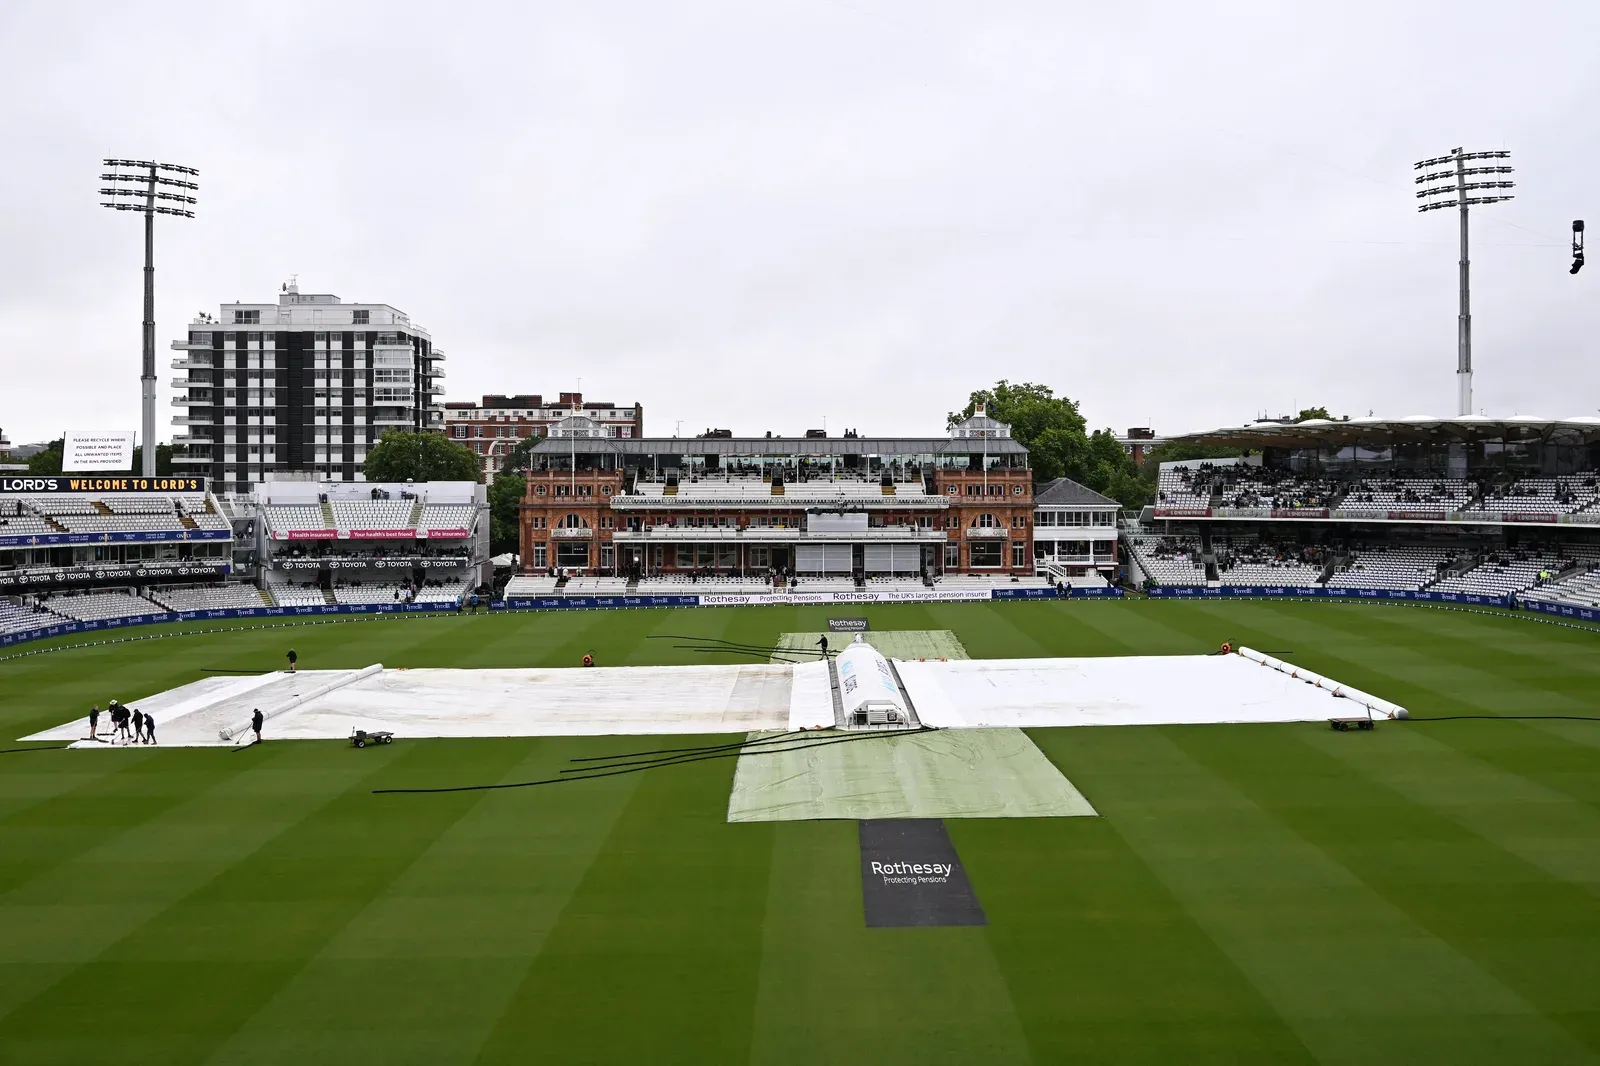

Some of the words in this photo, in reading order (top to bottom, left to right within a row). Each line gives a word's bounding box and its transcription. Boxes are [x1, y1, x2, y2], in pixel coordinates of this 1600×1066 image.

[4, 480, 58, 490] LORD'S
[70, 480, 127, 490] WELCOME
[132, 480, 148, 490] TO
[154, 480, 197, 489] LORD'S
[704, 596, 750, 604] Rothesay
[833, 593, 880, 601] Rothesay
[829, 620, 867, 628] Rothesay
[871, 861, 952, 877] Rothesay
[884, 876, 917, 885] Protecting
